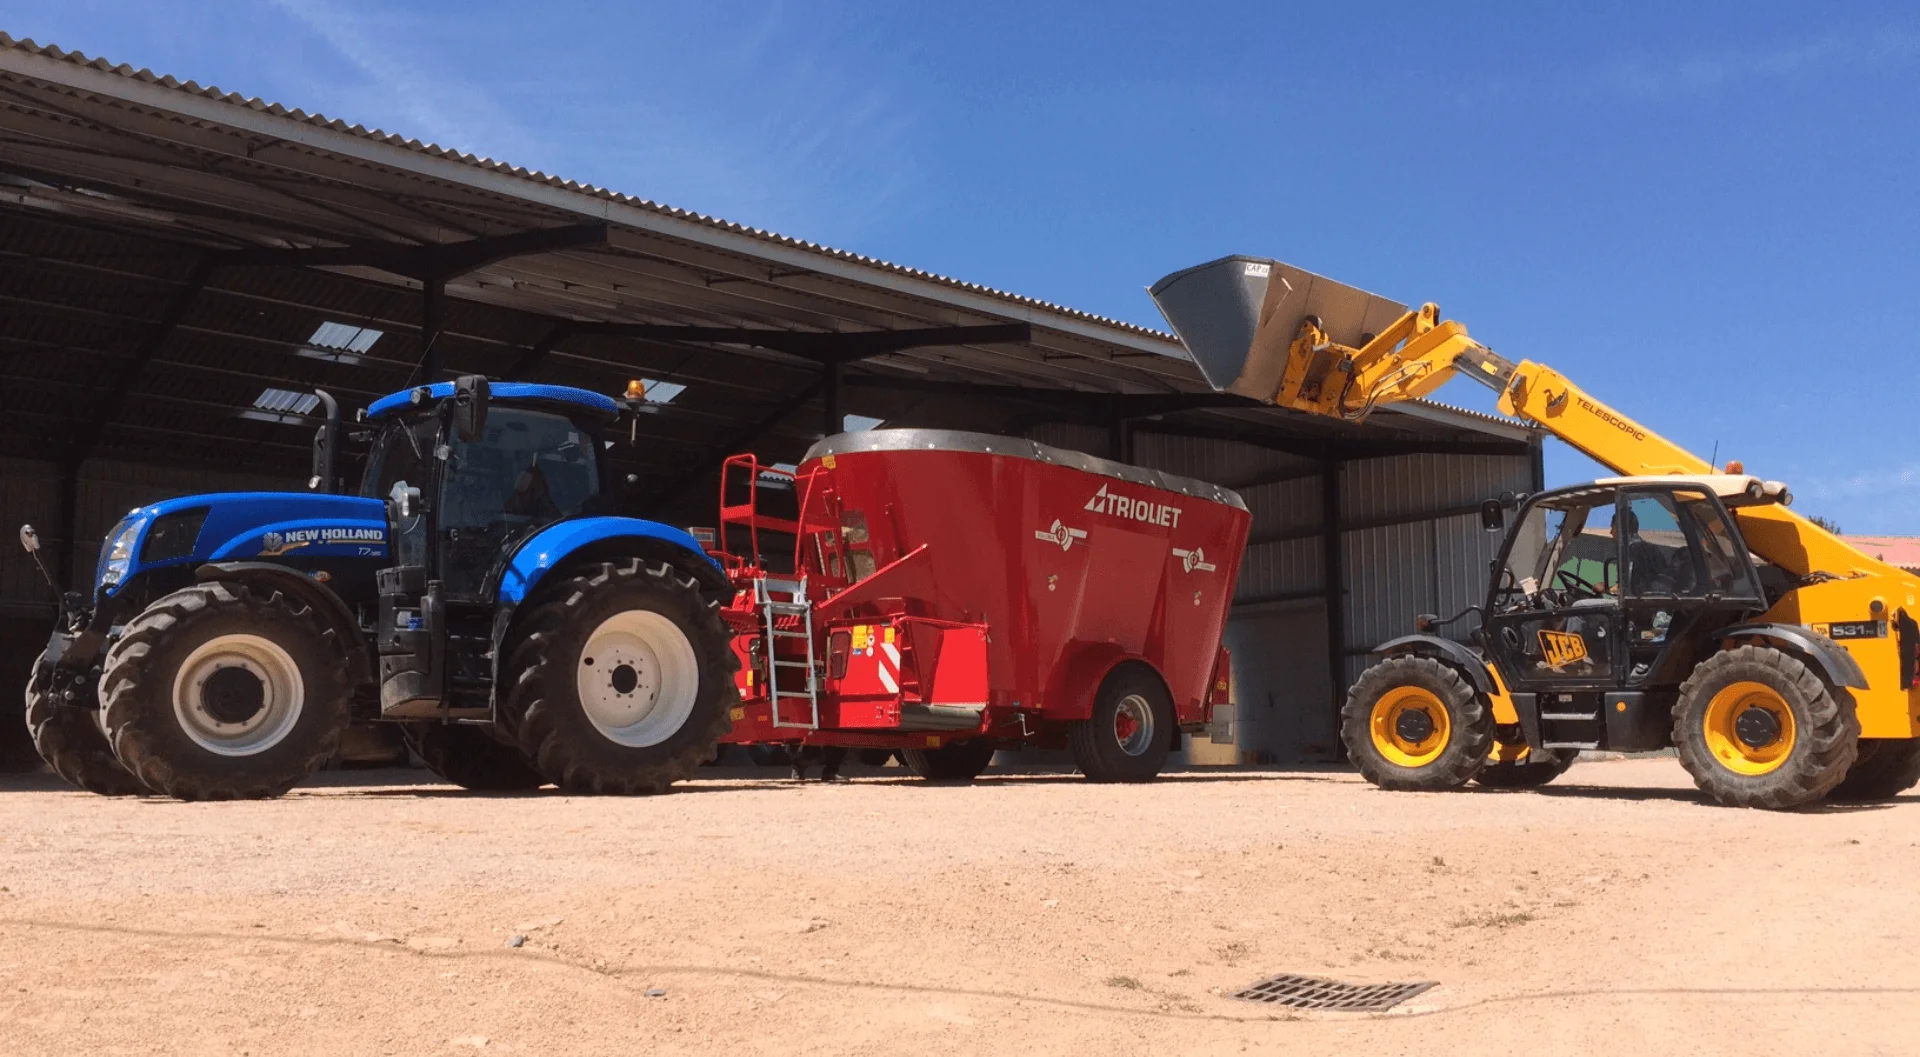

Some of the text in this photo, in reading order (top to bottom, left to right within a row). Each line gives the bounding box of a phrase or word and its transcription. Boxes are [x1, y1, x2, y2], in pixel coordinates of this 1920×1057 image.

[1577, 397, 1645, 441] TELESCOPIC
[1107, 493, 1182, 529] TRIOLIET
[285, 528, 383, 542] NEW HOLLAND
[1832, 624, 1865, 636] 531
[1546, 633, 1584, 665] JCB
